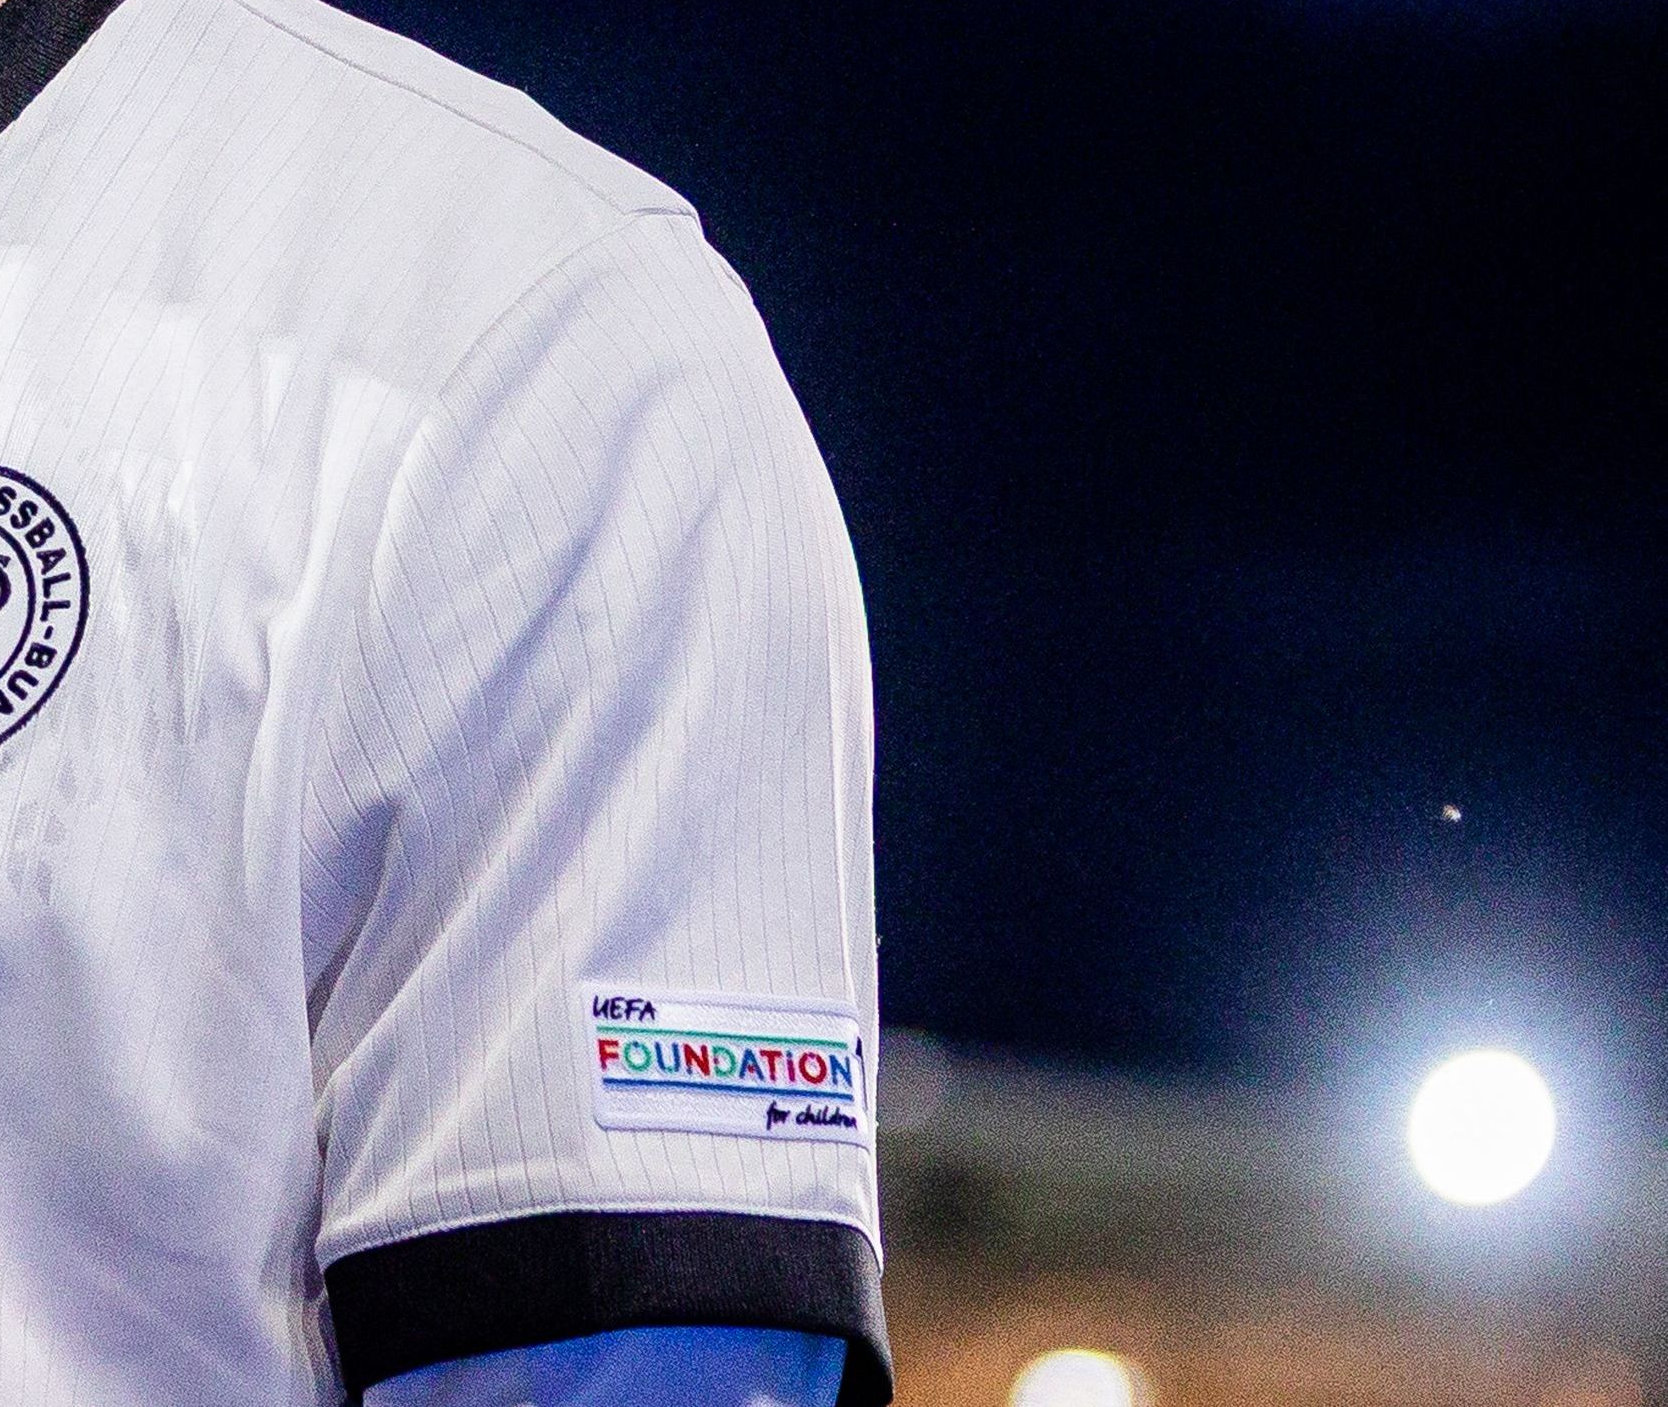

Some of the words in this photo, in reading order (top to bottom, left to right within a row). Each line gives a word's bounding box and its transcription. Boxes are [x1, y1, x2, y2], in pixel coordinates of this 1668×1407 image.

[592, 995, 658, 1022] UEFA
[766, 1100, 789, 1130] for
[796, 1104, 858, 1131] children
